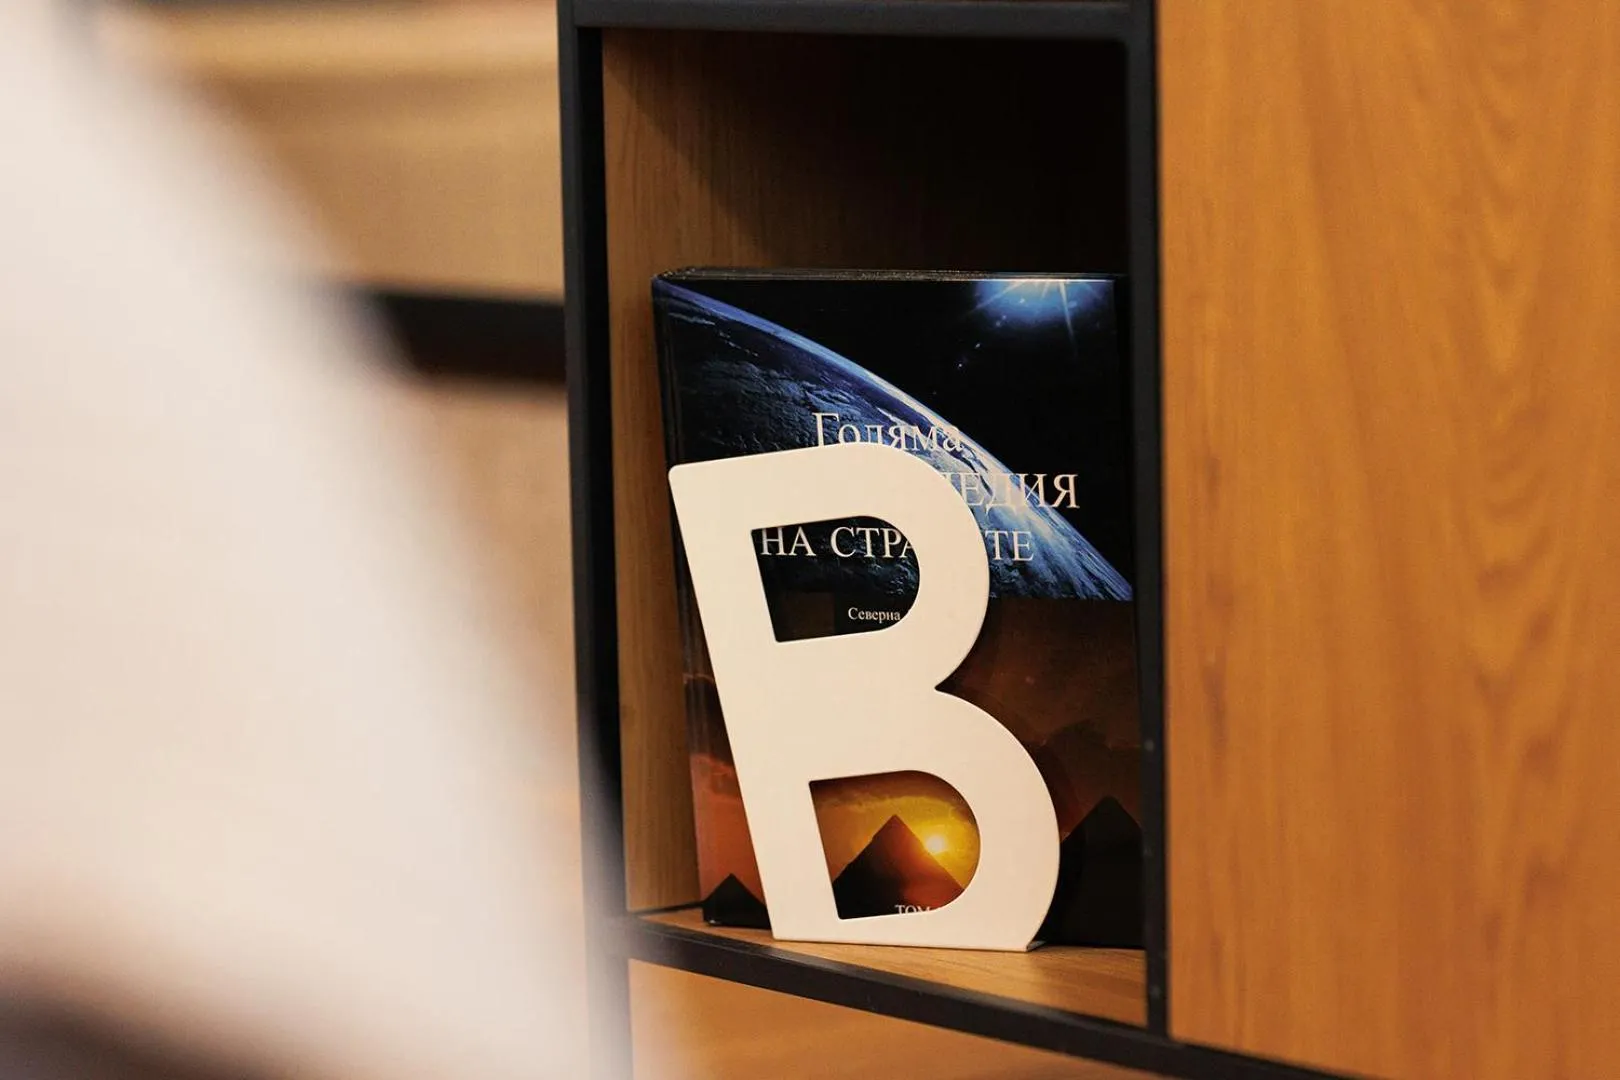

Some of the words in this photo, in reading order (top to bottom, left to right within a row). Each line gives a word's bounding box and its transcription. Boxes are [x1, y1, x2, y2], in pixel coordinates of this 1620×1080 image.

[812, 412, 965, 452] Голяма
[760, 526, 817, 556] НА
[847, 606, 901, 624] Северна
